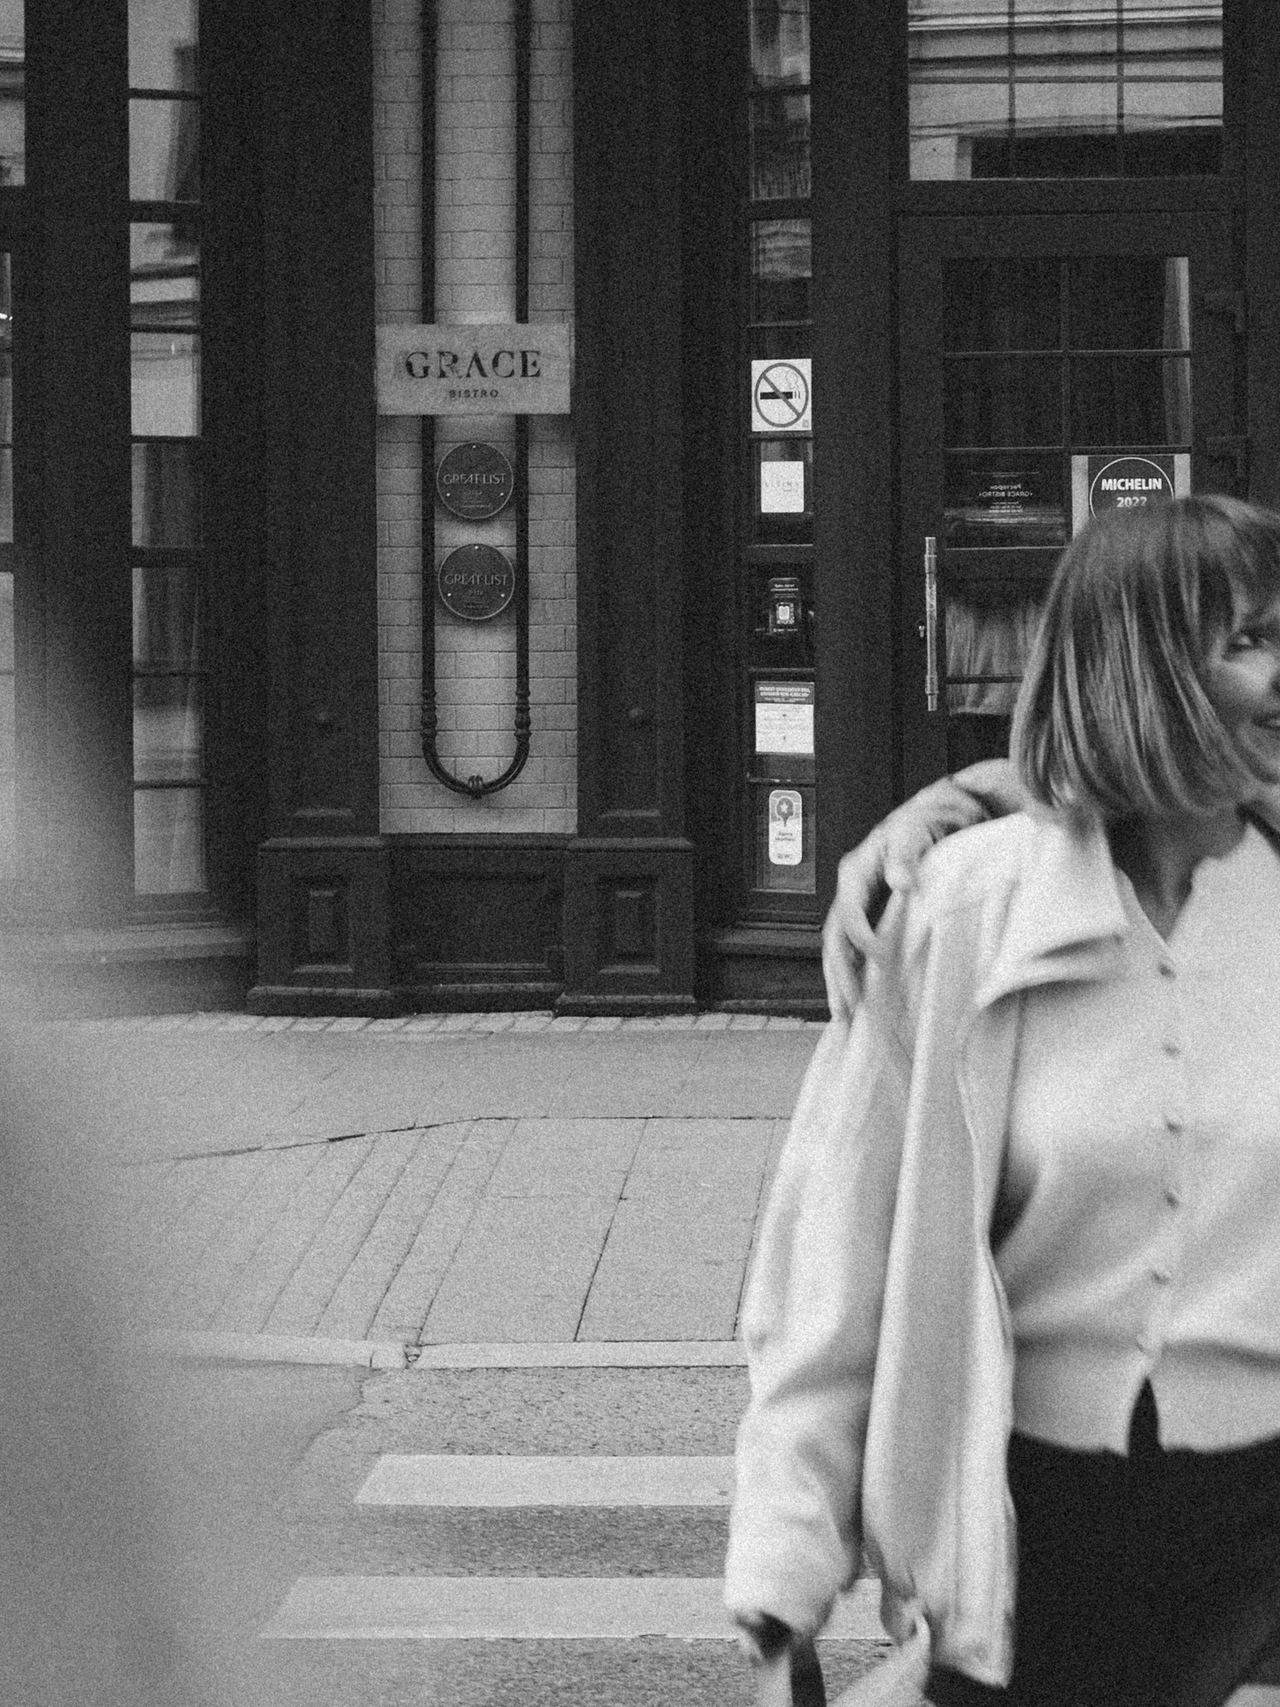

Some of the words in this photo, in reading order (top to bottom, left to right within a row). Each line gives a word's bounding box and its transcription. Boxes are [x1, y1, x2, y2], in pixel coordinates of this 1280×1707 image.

[405, 350, 541, 378] GRACE
[449, 389, 498, 398] BISTRO
[443, 474, 479, 485] GREAT
[482, 474, 506, 485] LIST
[1101, 478, 1162, 491] MICHELIN
[484, 574, 507, 585] LIST
